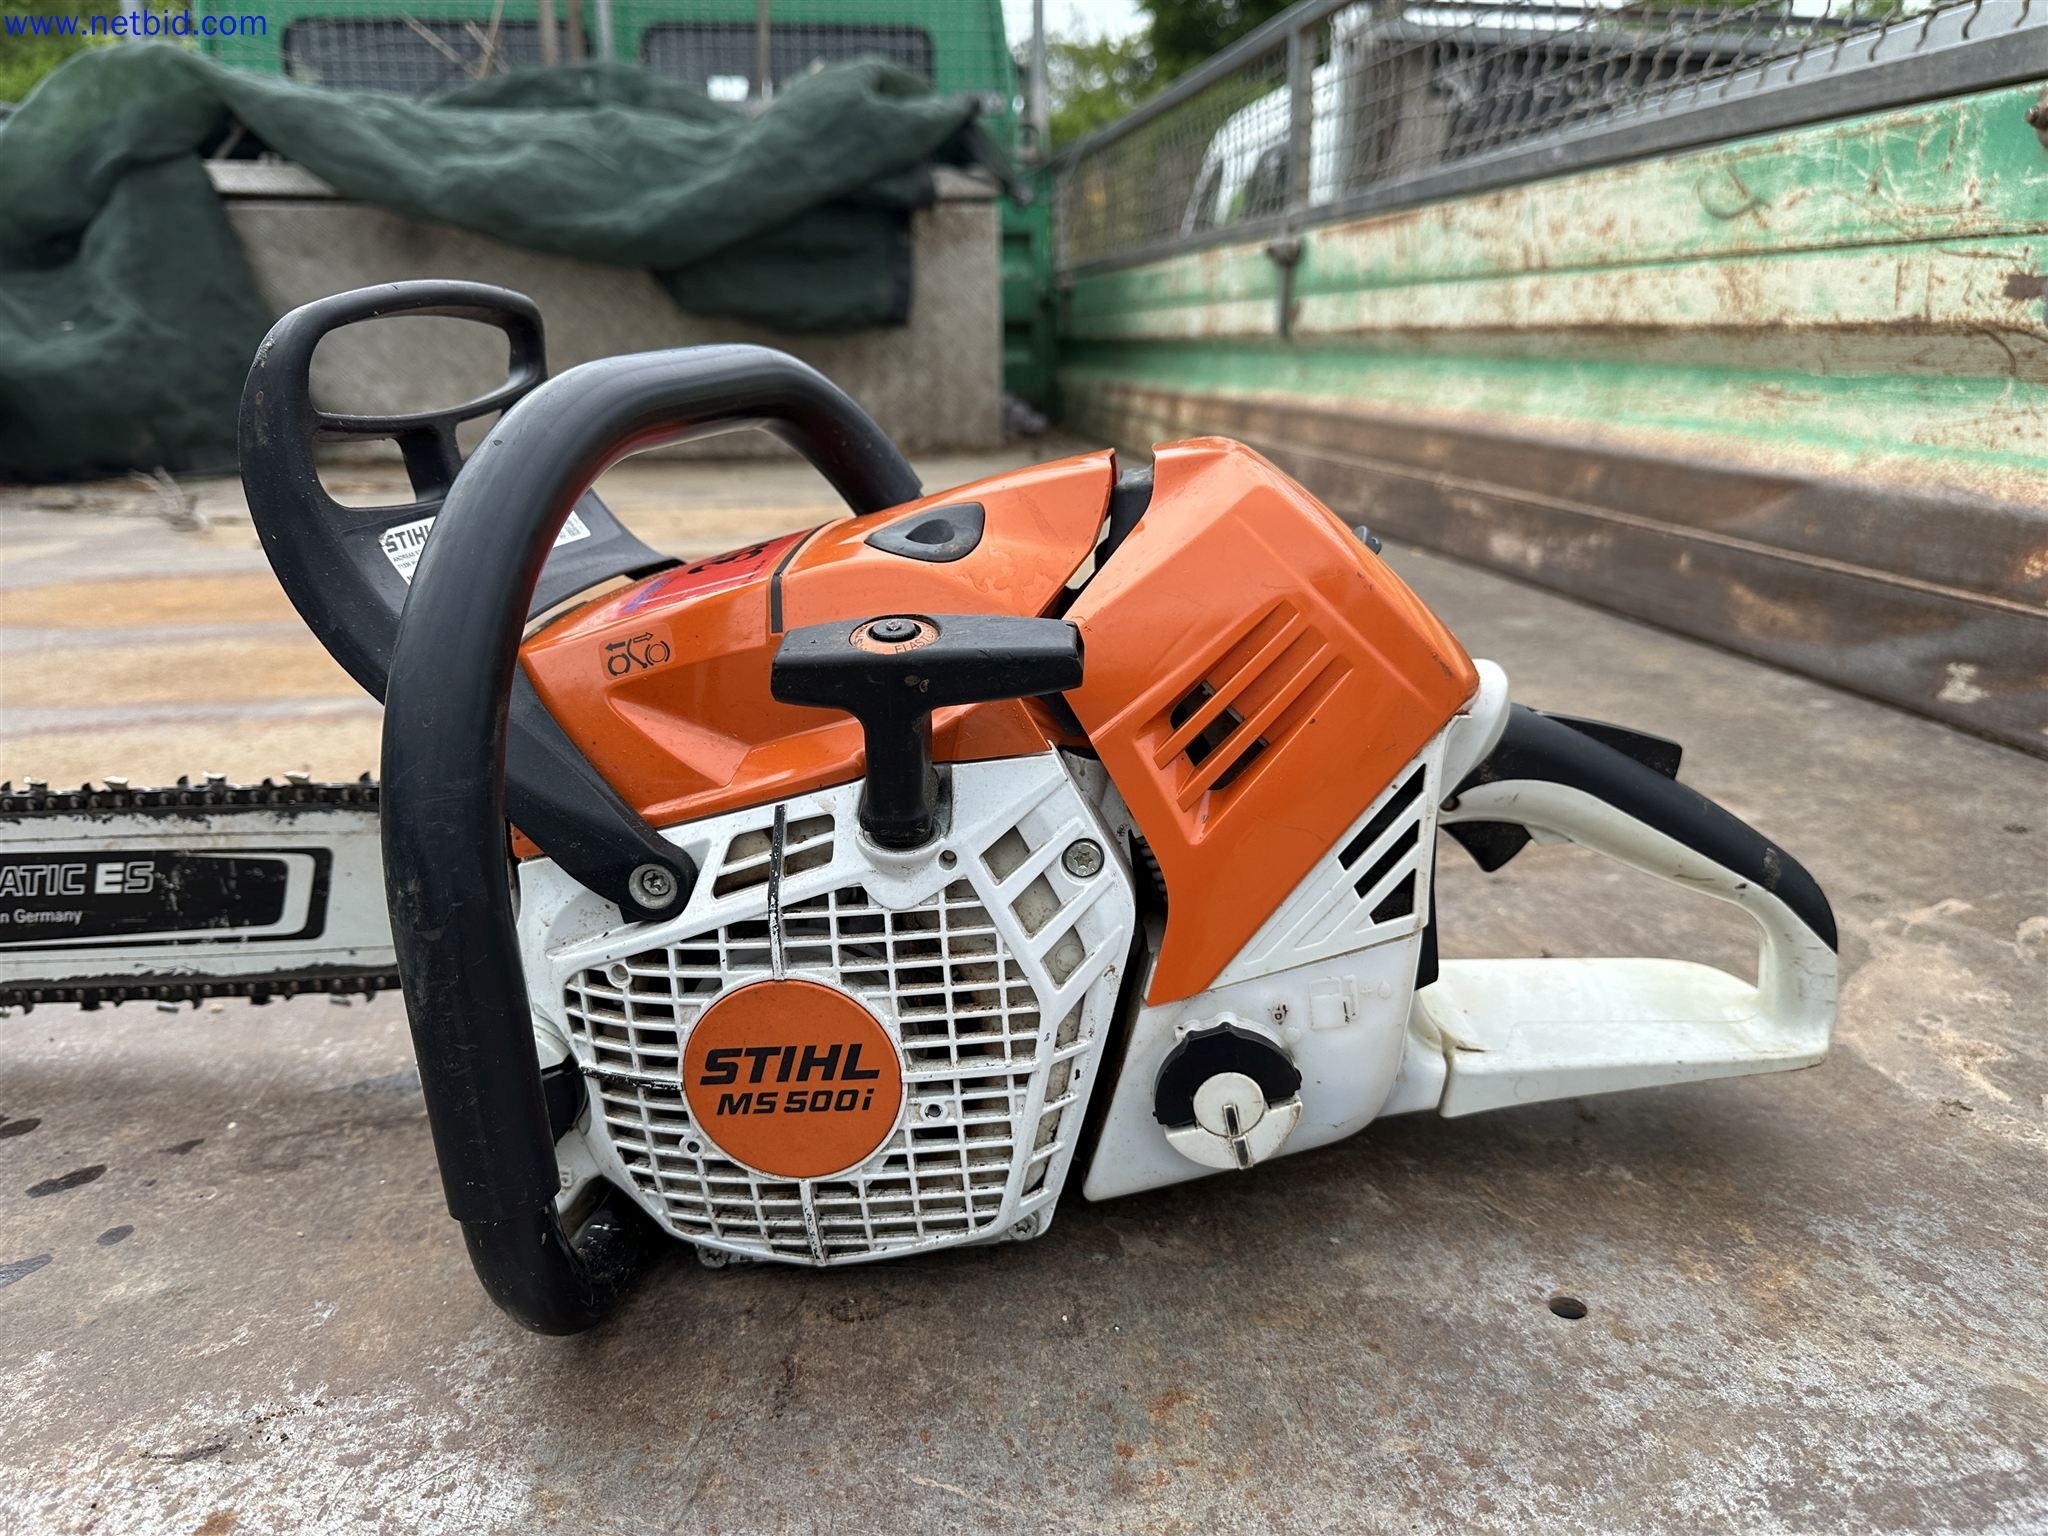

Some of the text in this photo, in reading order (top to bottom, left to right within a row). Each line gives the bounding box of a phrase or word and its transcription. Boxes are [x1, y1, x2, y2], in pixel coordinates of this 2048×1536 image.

[94, 860, 155, 894] ES
[13, 908, 83, 926] Germany
[700, 1043, 881, 1086] STIHL
[716, 1088, 875, 1116] MS 500i
